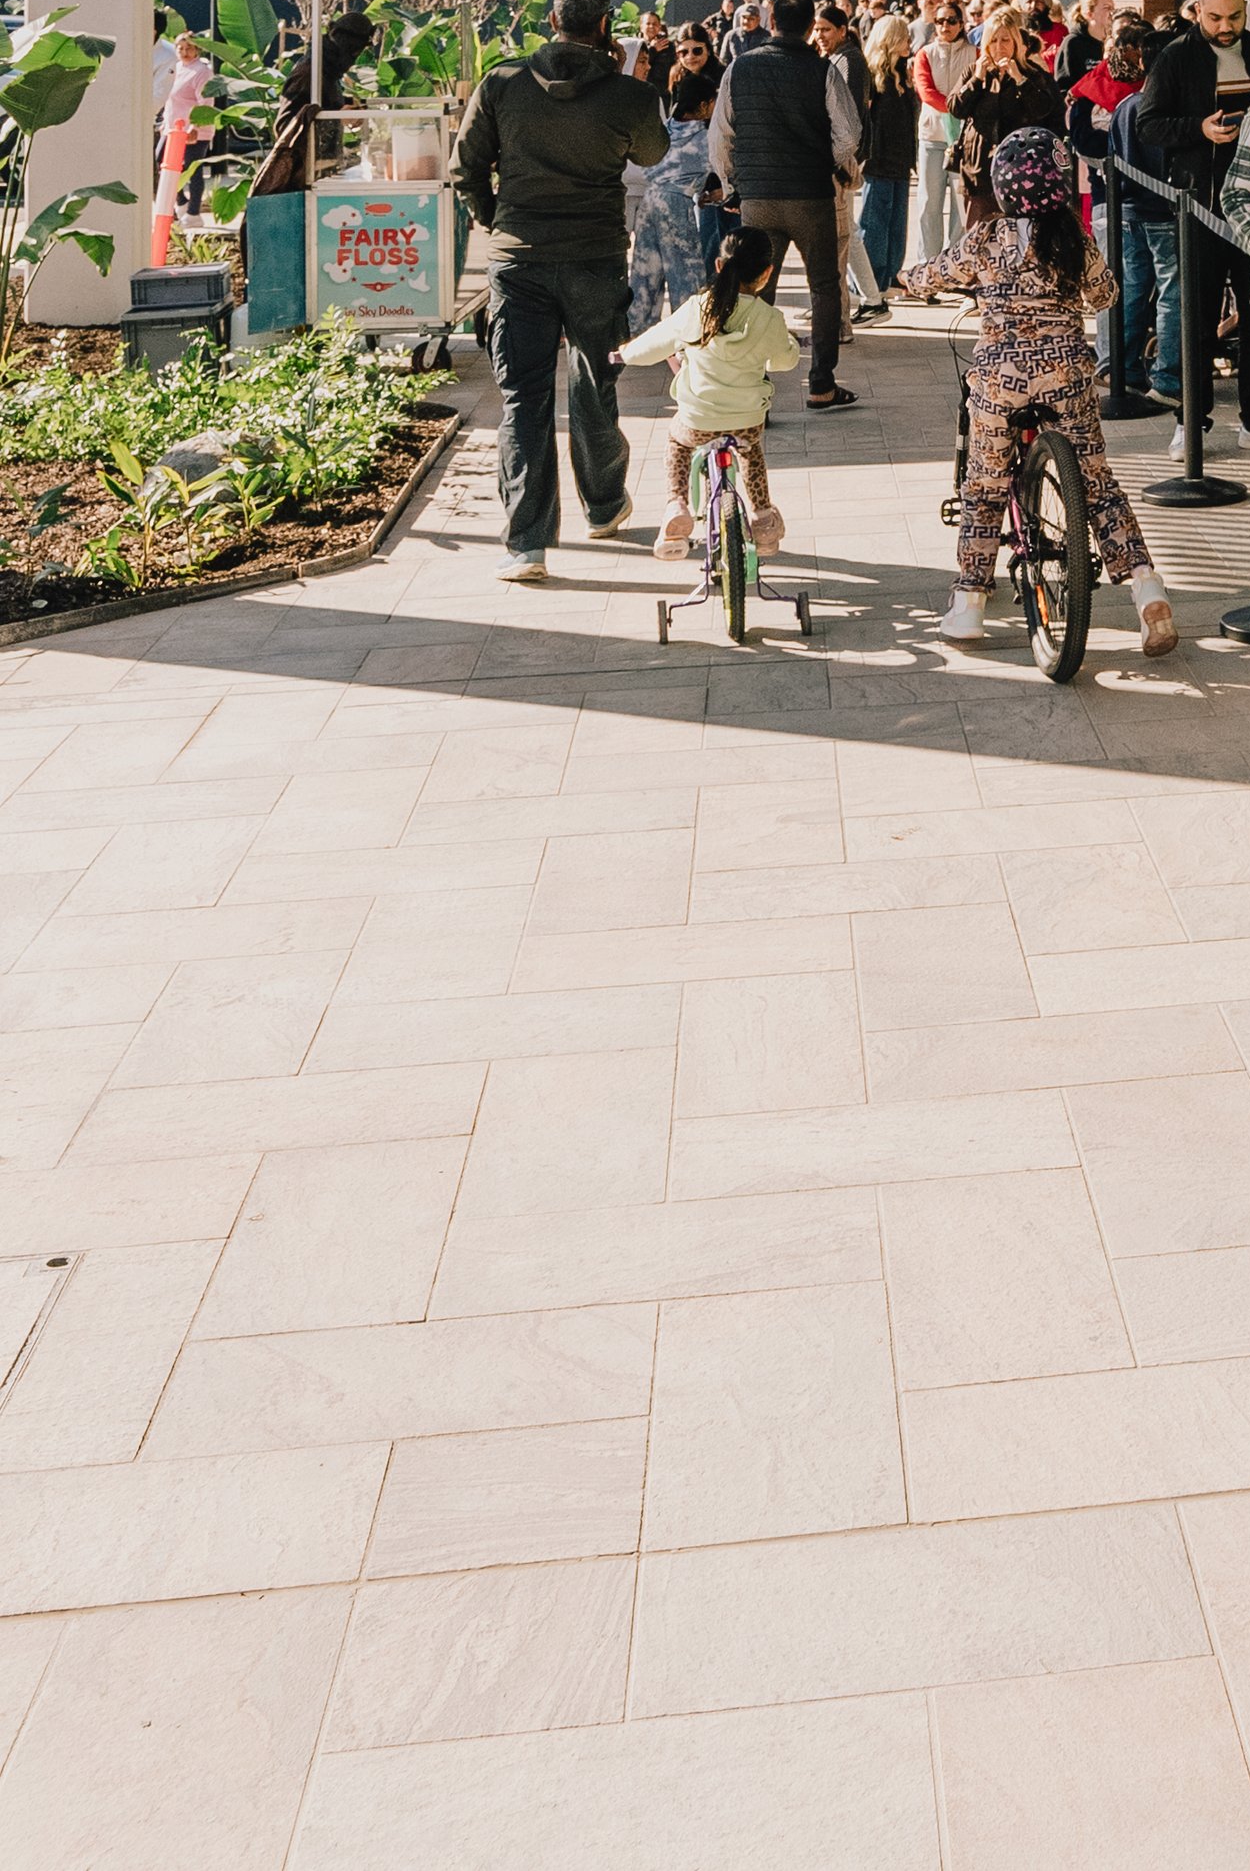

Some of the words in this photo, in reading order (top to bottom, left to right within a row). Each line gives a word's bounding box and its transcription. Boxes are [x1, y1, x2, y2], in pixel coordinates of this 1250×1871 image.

[339, 228, 416, 246] FAIRY
[336, 247, 419, 266] FLOSS
[358, 305, 376, 317] Sky
[378, 304, 415, 316] Doodles
